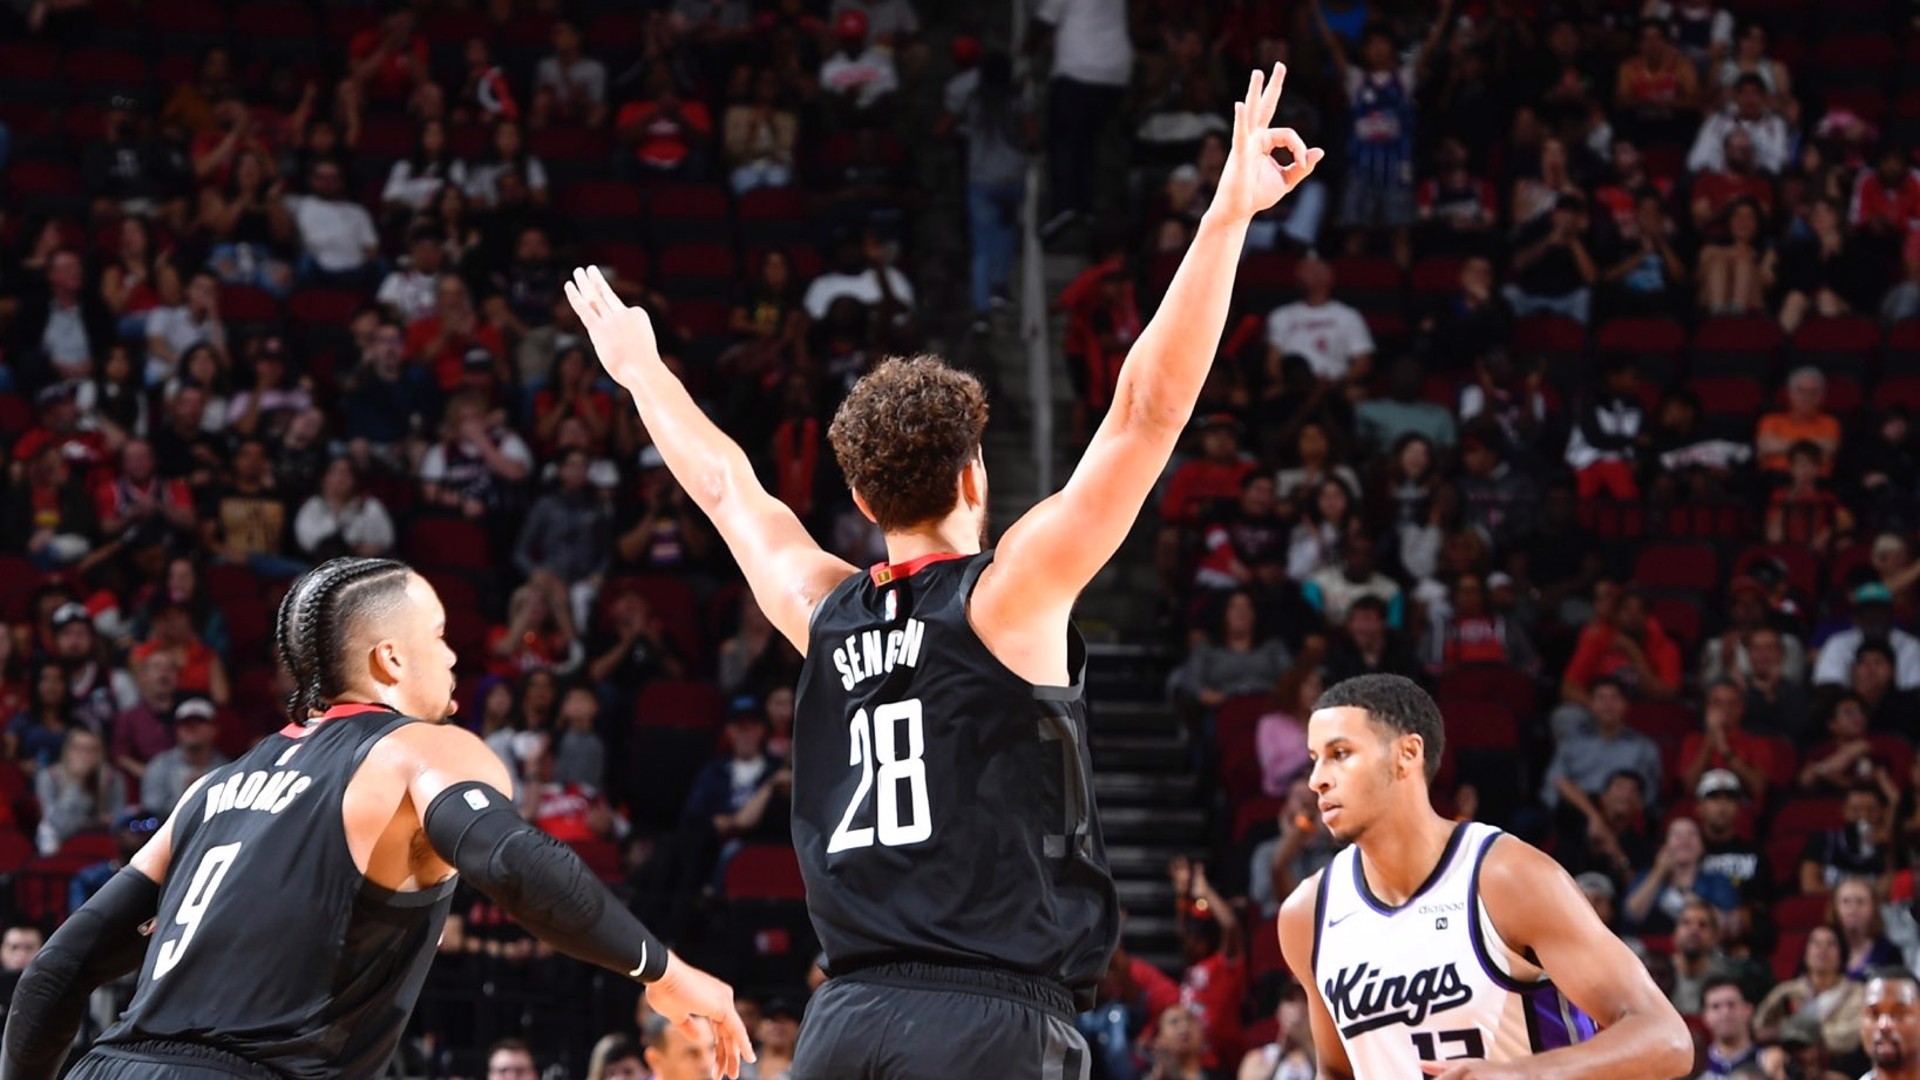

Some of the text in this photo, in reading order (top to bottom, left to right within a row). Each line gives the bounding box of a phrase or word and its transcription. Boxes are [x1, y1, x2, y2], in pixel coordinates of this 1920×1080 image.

[826, 698, 933, 854] 28
[152, 841, 242, 980] 9
[1325, 962, 1473, 1040] Kings
